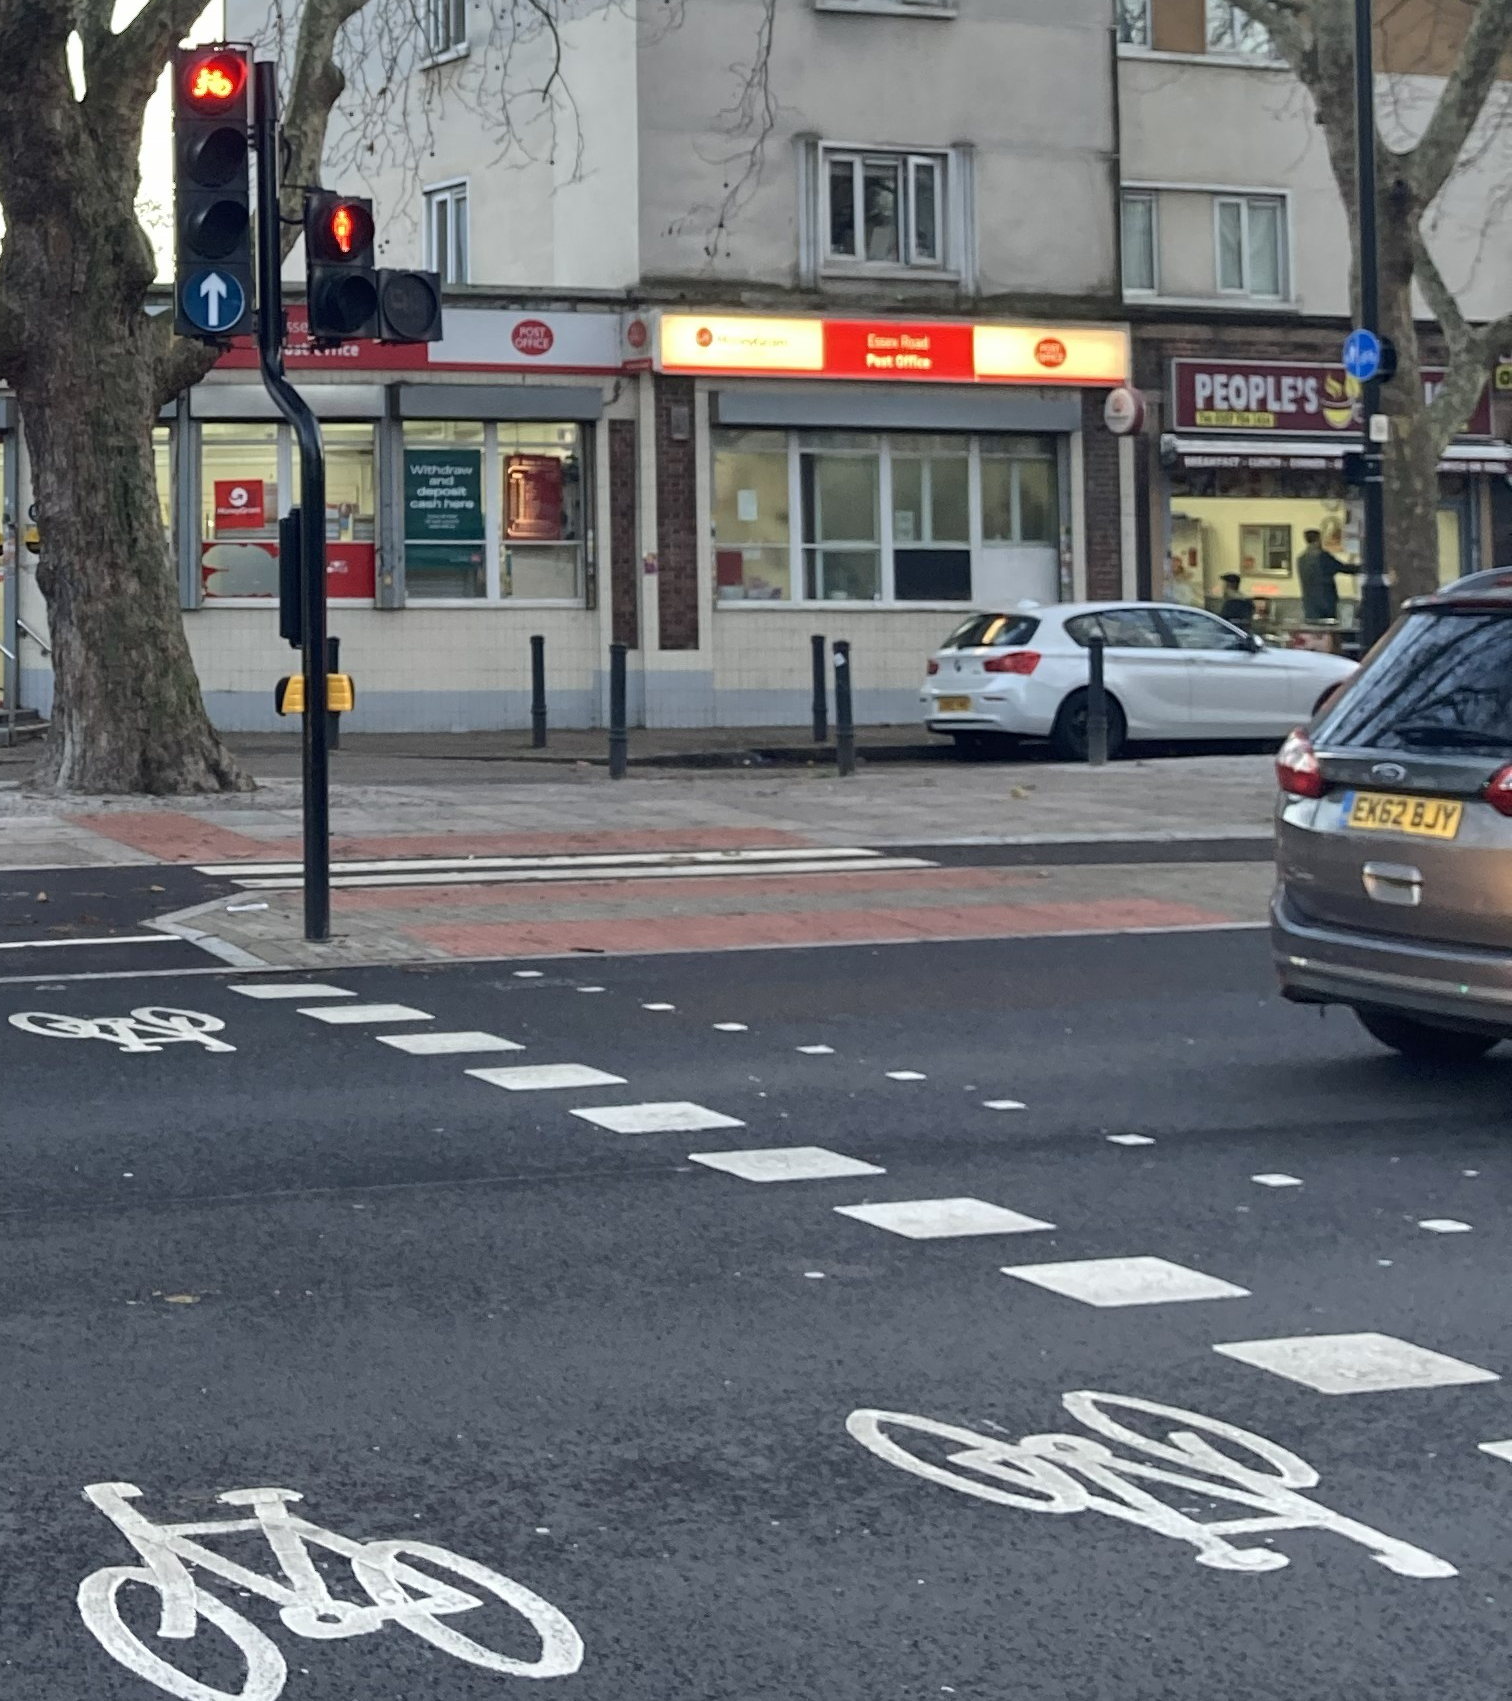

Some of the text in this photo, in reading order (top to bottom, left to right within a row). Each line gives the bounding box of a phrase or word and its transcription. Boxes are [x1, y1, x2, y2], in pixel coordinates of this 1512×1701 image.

[287, 322, 309, 334] sse
[519, 326, 546, 338] POST
[515, 338, 549, 349] OFFICE
[867, 333, 930, 350] Essex Road
[284, 342, 310, 356] ost
[866, 353, 932, 370] Post Office
[1195, 373, 1319, 414] PEOPLE'S
[410, 465, 474, 475] Withdraw
[428, 476, 455, 486] and
[416, 486, 468, 499] deposit
[409, 499, 475, 509] cash here
[1353, 796, 1459, 831] EK62 BJY
